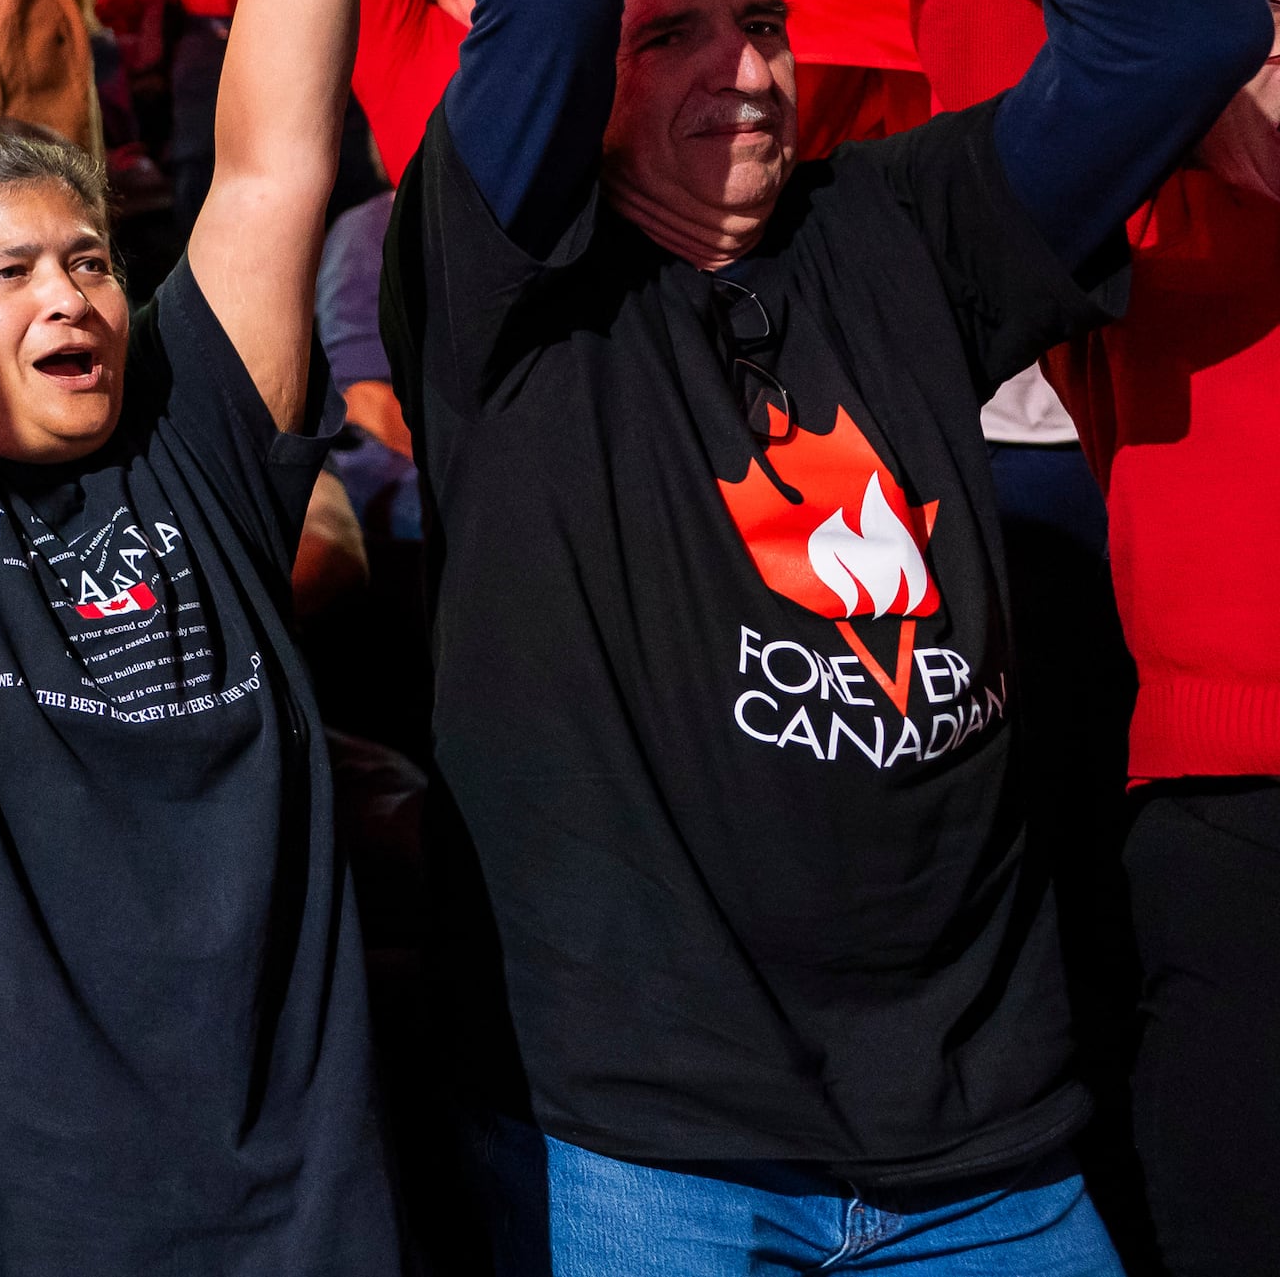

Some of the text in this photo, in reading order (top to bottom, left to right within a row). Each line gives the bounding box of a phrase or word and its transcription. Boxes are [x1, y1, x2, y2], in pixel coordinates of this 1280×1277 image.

[80, 629, 102, 642] your
[103, 621, 136, 635] second
[91, 652, 108, 663] was
[152, 631, 165, 640] on
[114, 660, 157, 680] buildings
[157, 656, 171, 666] are
[739, 619, 971, 718] FOREVER
[36, 689, 66, 708] THE
[69, 696, 108, 716] BEST
[110, 704, 165, 723] HOCKEY
[220, 686, 245, 704] THE
[117, 691, 135, 704] leaf
[145, 684, 162, 694] our
[733, 672, 1006, 770] CANADIAN
